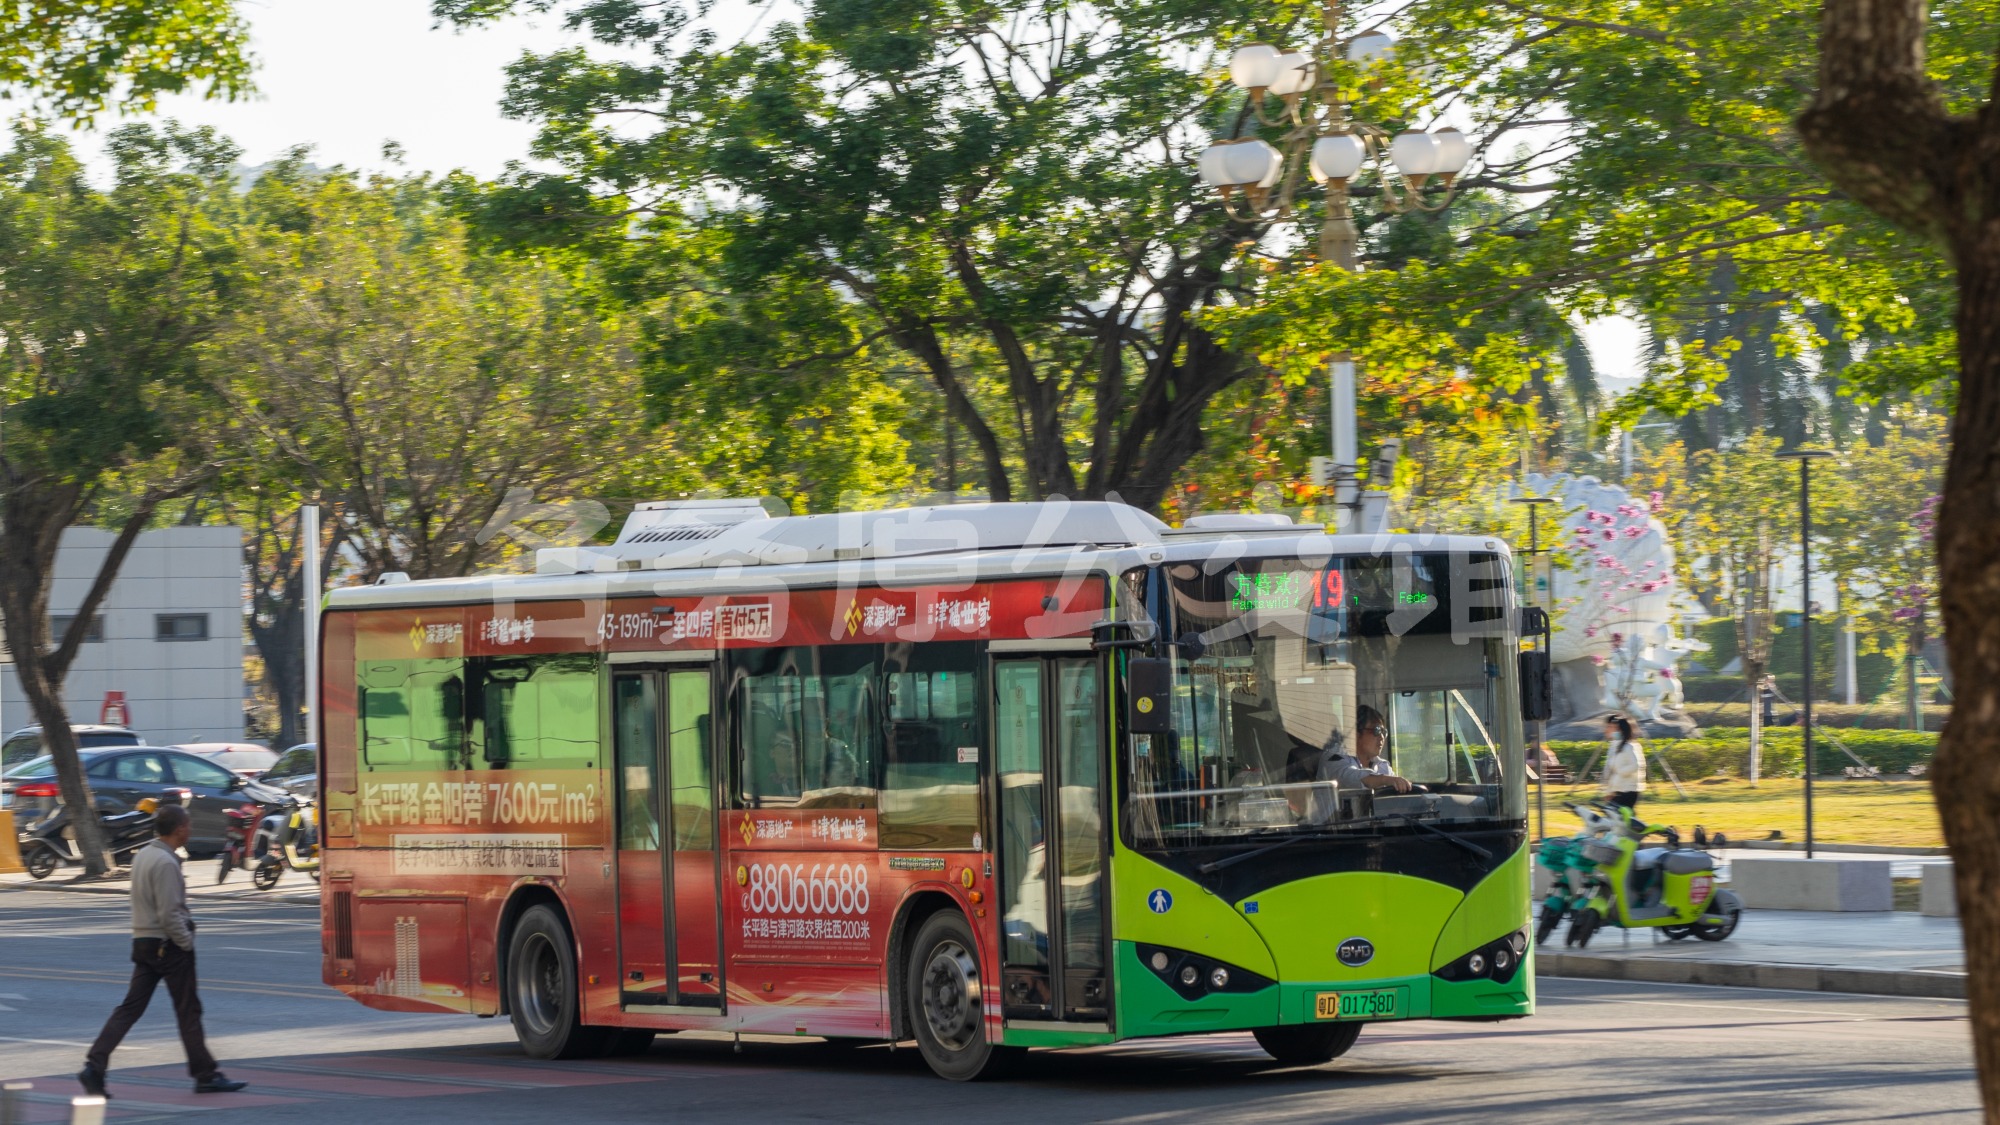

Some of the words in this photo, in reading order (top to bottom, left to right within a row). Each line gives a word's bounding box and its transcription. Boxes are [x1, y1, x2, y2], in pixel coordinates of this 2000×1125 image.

[1310, 569, 1344, 608] 19
[863, 604, 907, 628] 深源地产
[756, 819, 793, 839] 深源地产
[750, 863, 870, 915] 88066688
[742, 918, 871, 940] 长平路与津河路交界往西200米
[1341, 945, 1372, 959] BYD
